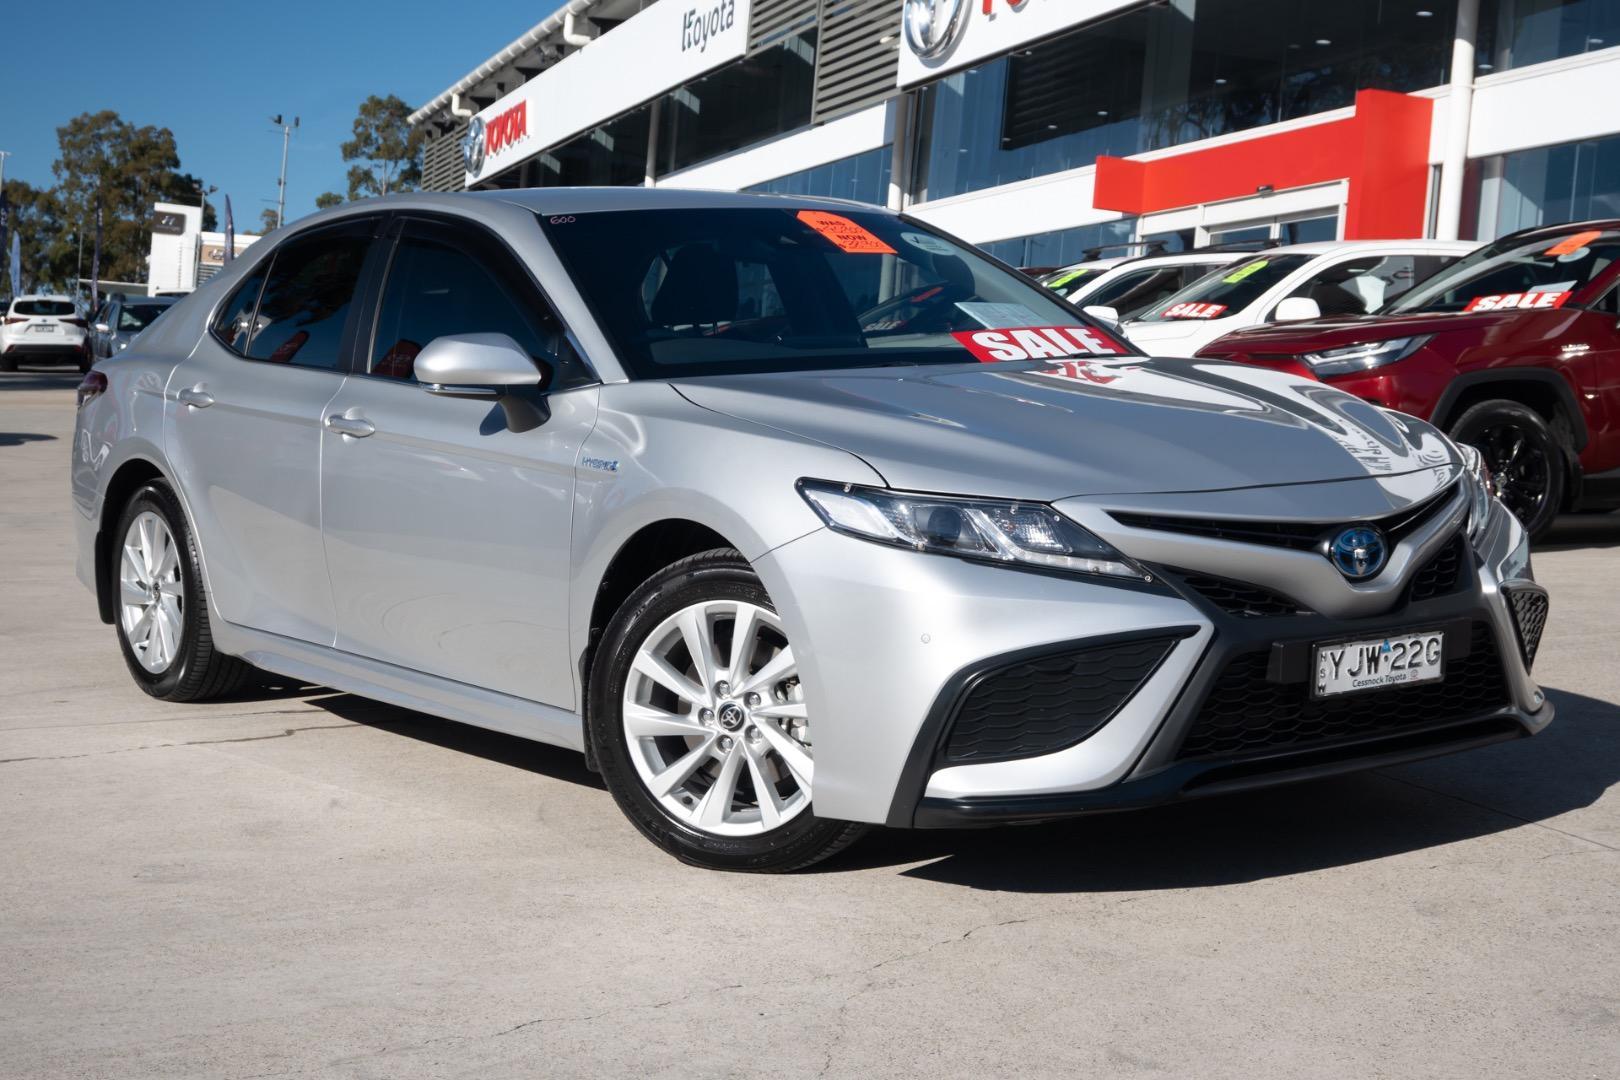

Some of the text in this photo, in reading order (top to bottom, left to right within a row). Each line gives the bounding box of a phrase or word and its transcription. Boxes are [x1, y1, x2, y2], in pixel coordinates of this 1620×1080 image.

[485, 100, 527, 156] TOYOTA
[1164, 303, 1224, 318] SALE
[1472, 292, 1562, 312] SALE
[972, 328, 1117, 361] SALE
[1352, 675, 1384, 688] Cessnock
[1385, 673, 1407, 684] Toyota
